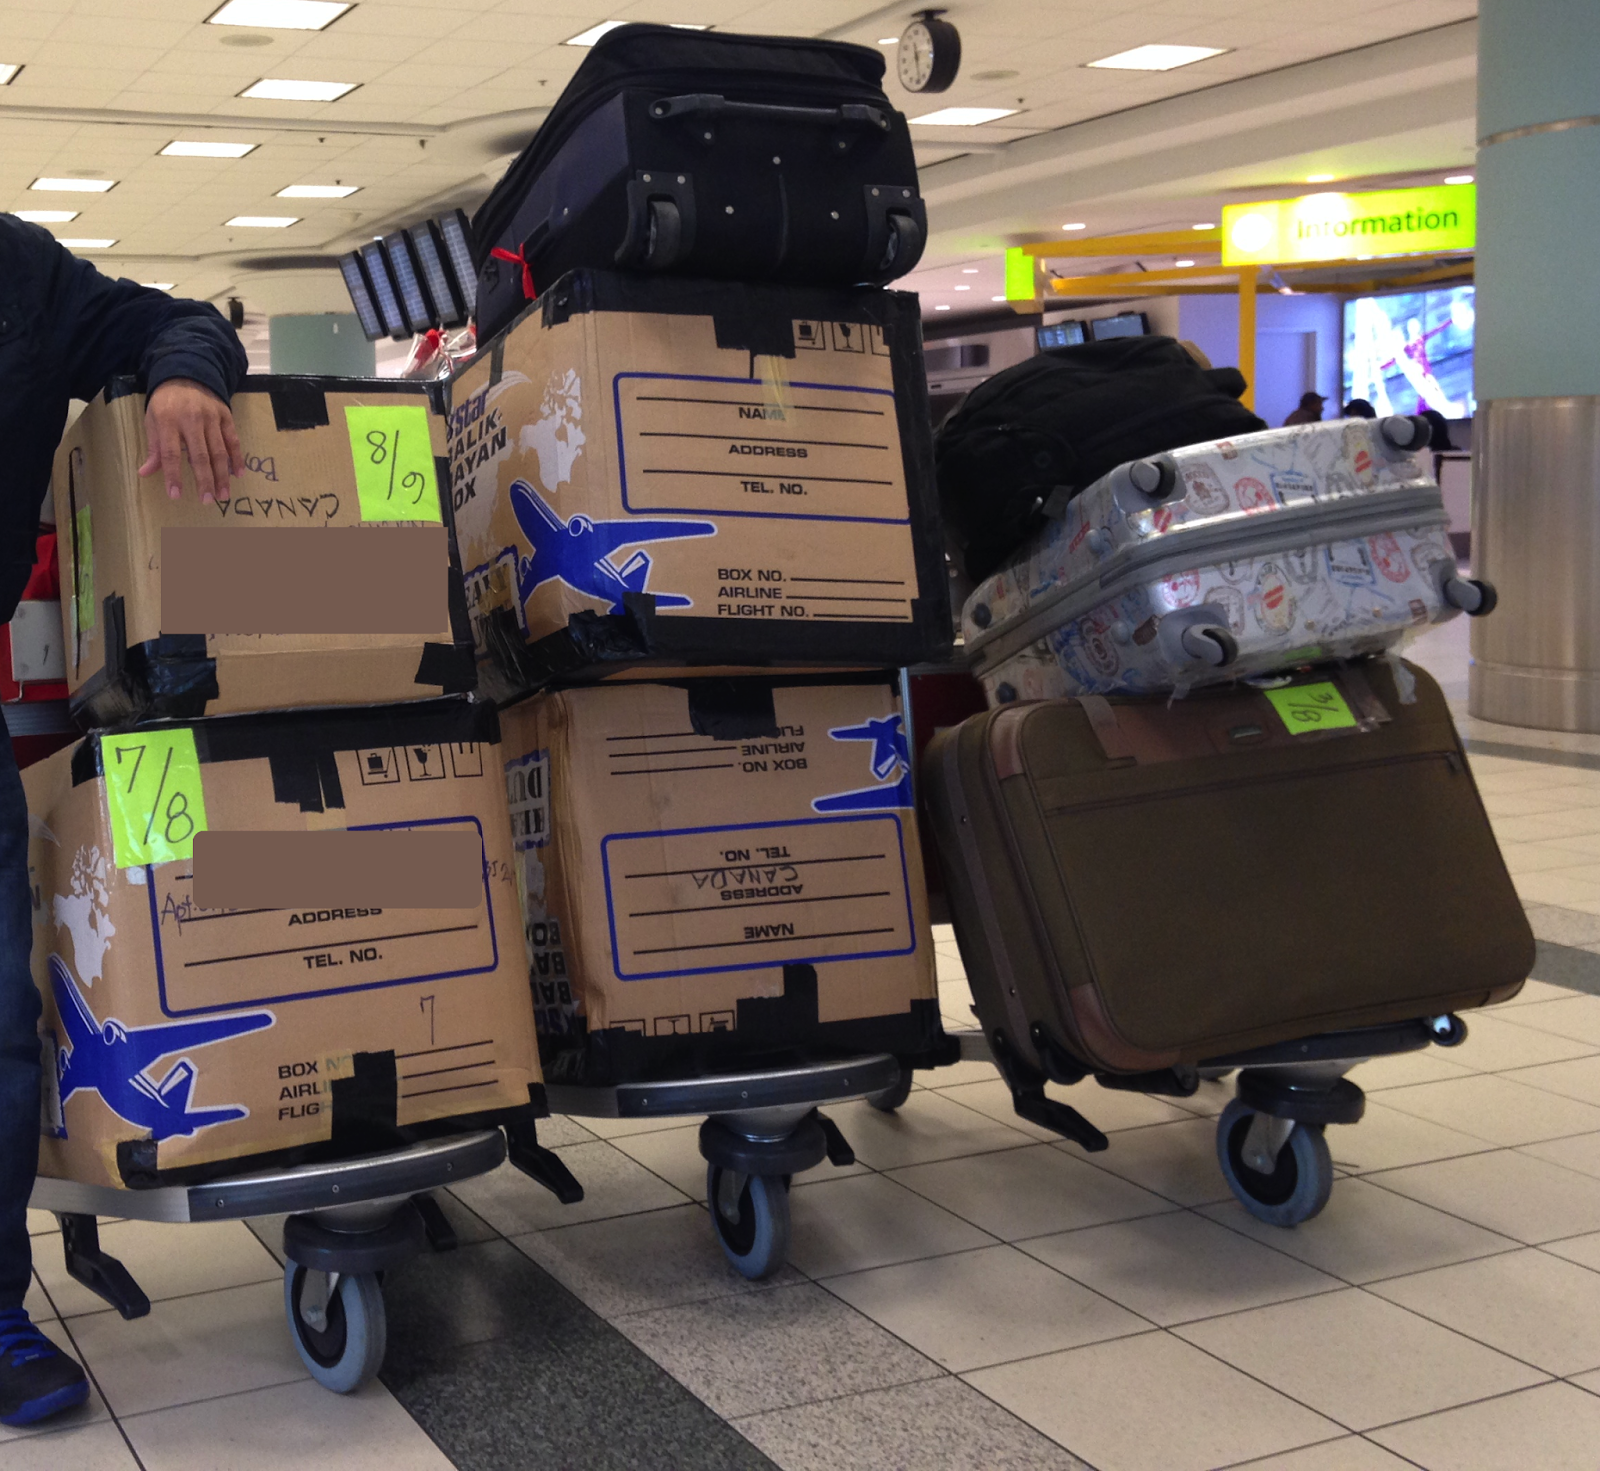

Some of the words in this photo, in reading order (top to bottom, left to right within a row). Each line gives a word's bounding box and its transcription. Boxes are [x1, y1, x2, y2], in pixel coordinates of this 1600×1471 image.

[1298, 207, 1458, 239] Information
[448, 407, 503, 465] ALIK-
[729, 445, 808, 458] ADDRESS
[740, 481, 774, 494] TEL.
[779, 483, 807, 496] NO.
[214, 493, 340, 519] CANADA
[717, 568, 752, 581] BOX
[758, 570, 787, 582] NO.
[717, 586, 783, 599] AIRLINE
[717, 604, 775, 617] FLIGHT
[781, 605, 809, 617] NO.
[741, 742, 805, 756] AIRLINE
[738, 761, 769, 773] NO.
[772, 758, 808, 771] BOX
[115, 745, 194, 845] 7/8
[720, 849, 750, 862] NO.
[756, 846, 791, 859] TEL.
[691, 864, 799, 890] CANADA
[720, 884, 804, 901] ADDRESS
[288, 908, 383, 927] ADDRESS
[743, 922, 795, 940] NAME
[303, 953, 343, 969] TEL.
[349, 947, 383, 963] NO.
[277, 1061, 319, 1080] BOX
[278, 1079, 333, 1101] AIRLI
